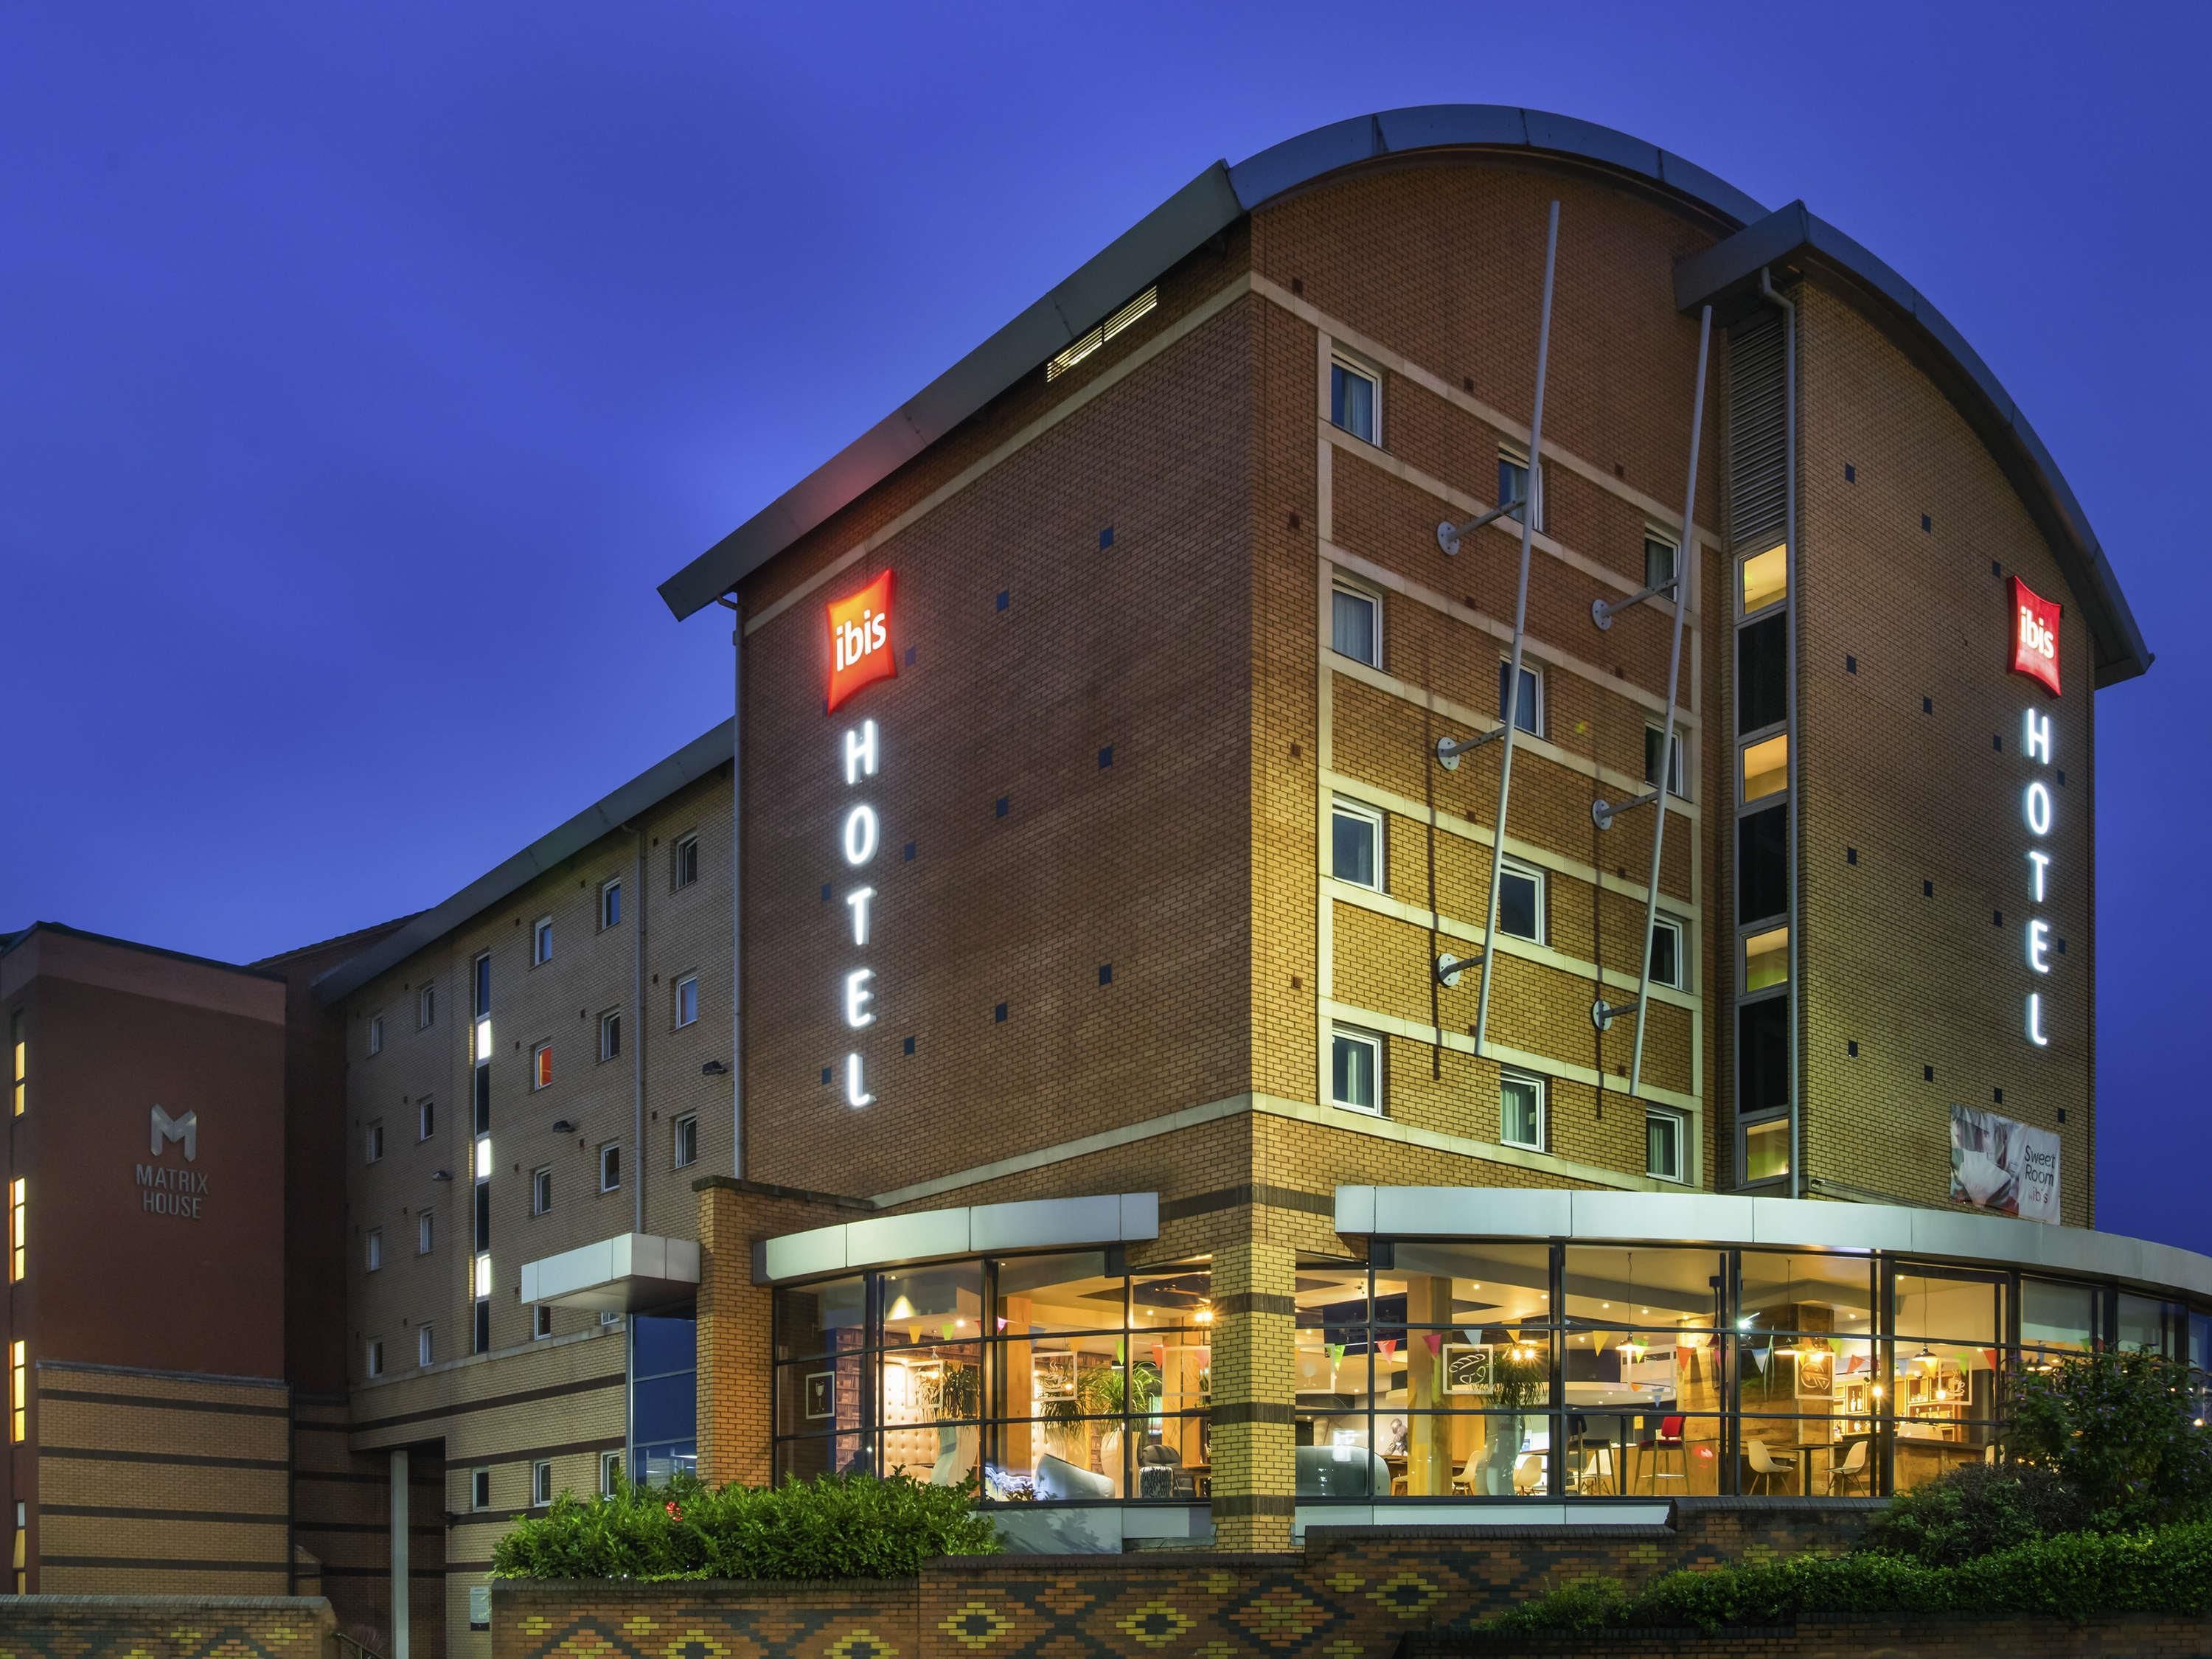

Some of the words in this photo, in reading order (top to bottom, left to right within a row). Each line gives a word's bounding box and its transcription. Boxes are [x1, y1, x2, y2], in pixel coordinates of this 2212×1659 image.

[836, 609, 886, 672] ibis
[2020, 605, 2054, 658] ibis
[2025, 708, 2050, 1046] HOTEL
[846, 720, 877, 1107] HOTEL
[2024, 1144, 2056, 1168] Sweet
[2025, 1164, 2053, 1186] Room
[136, 1164, 209, 1194] MATRIX
[143, 1191, 201, 1219] HOUSE
